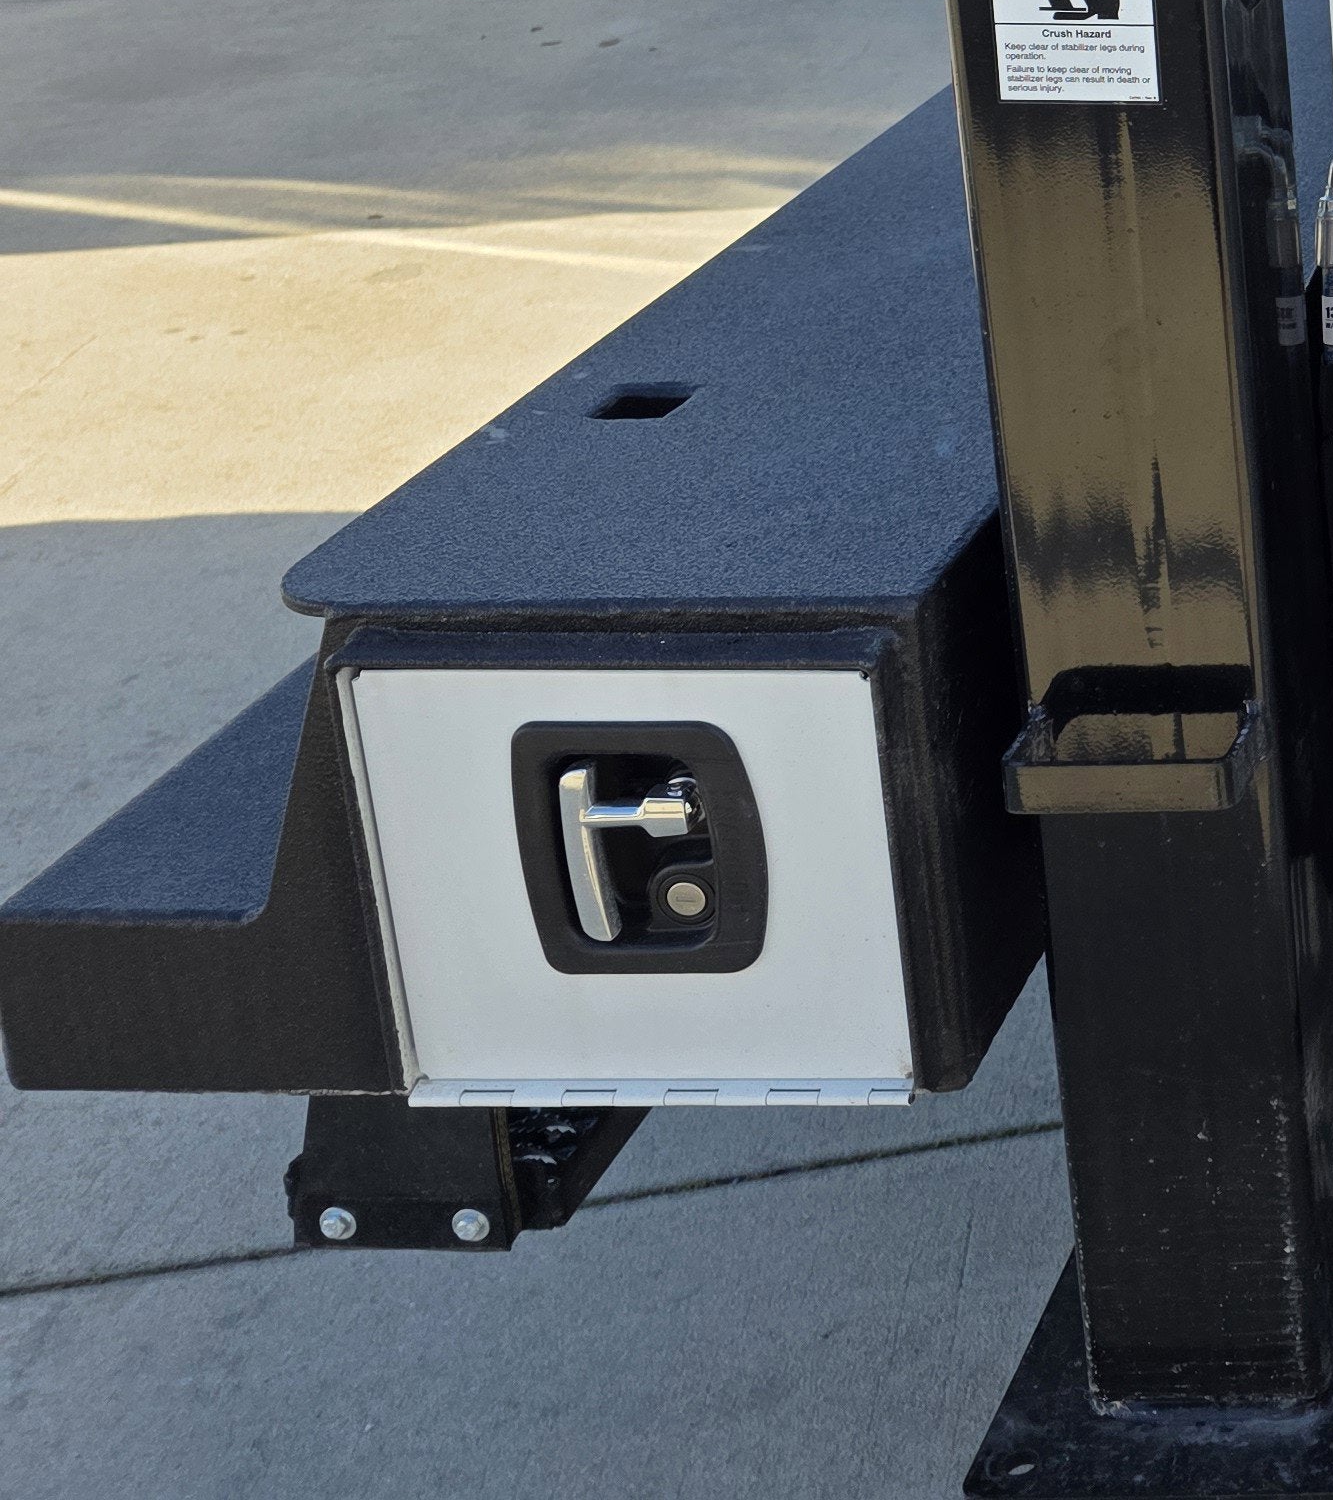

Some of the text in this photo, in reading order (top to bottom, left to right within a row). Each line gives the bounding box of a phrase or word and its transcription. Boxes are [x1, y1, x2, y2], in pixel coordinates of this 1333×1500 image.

[1041, 28, 1112, 39] Crush Hazard
[1004, 42, 1145, 54] Keep clear of stabilizer legs during
[1005, 52, 1046, 62] operation.
[1006, 65, 1132, 76] Failure to keep clear of moving
[1007, 74, 1044, 83] stabilizer
[1045, 75, 1063, 85] legs
[1065, 76, 1081, 84] can
[1082, 75, 1105, 84] result
[1107, 75, 1115, 84] in
[1116, 75, 1140, 84] death
[1008, 84, 1065, 94] serious injury.
